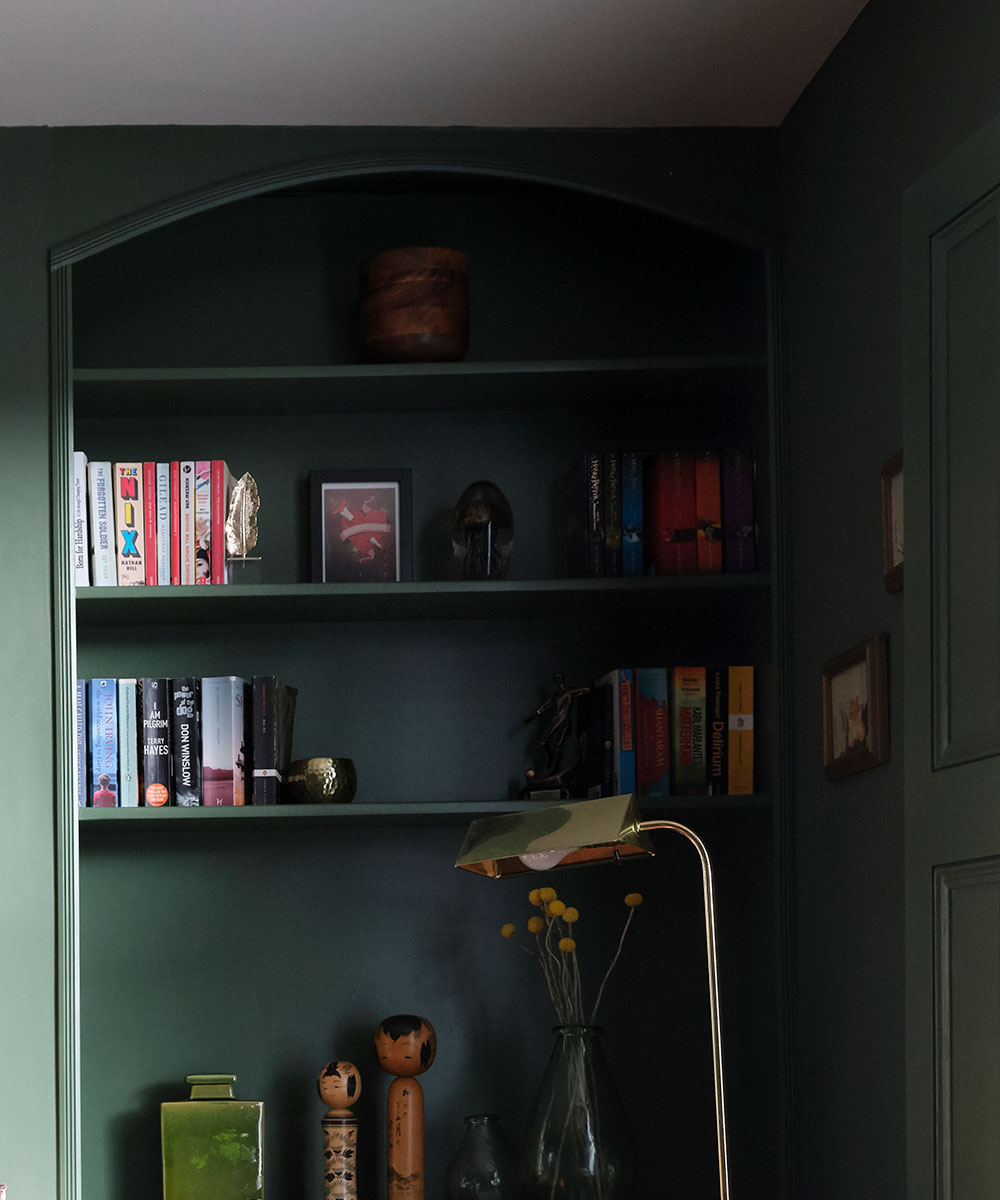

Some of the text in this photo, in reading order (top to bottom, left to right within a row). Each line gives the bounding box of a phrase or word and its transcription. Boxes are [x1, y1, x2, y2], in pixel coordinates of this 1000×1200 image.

[120, 467, 138, 476] THE
[97, 478, 107, 519] FORGOTTEN
[159, 475, 167, 521] GILEAD
[75, 519, 85, 544] Hardship
[99, 521, 108, 550] SOLDIER
[75, 546, 84, 554] for
[75, 555, 84, 569] Born
[174, 691, 194, 700] power
[149, 711, 161, 719] AM
[153, 702, 157, 710] I
[176, 705, 194, 719] dog
[103, 694, 114, 768] JOHN IRVING
[143, 719, 168, 728] PILGRIM
[655, 706, 665, 767] SHANTARAM
[680, 706, 692, 767] MATTERHORN
[692, 706, 703, 766] KARL MARLANTES
[144, 745, 169, 756] HAYES
[180, 724, 191, 787] DON WINSLOW
[712, 720, 725, 776] Delirium
[95, 756, 103, 772] Garp
